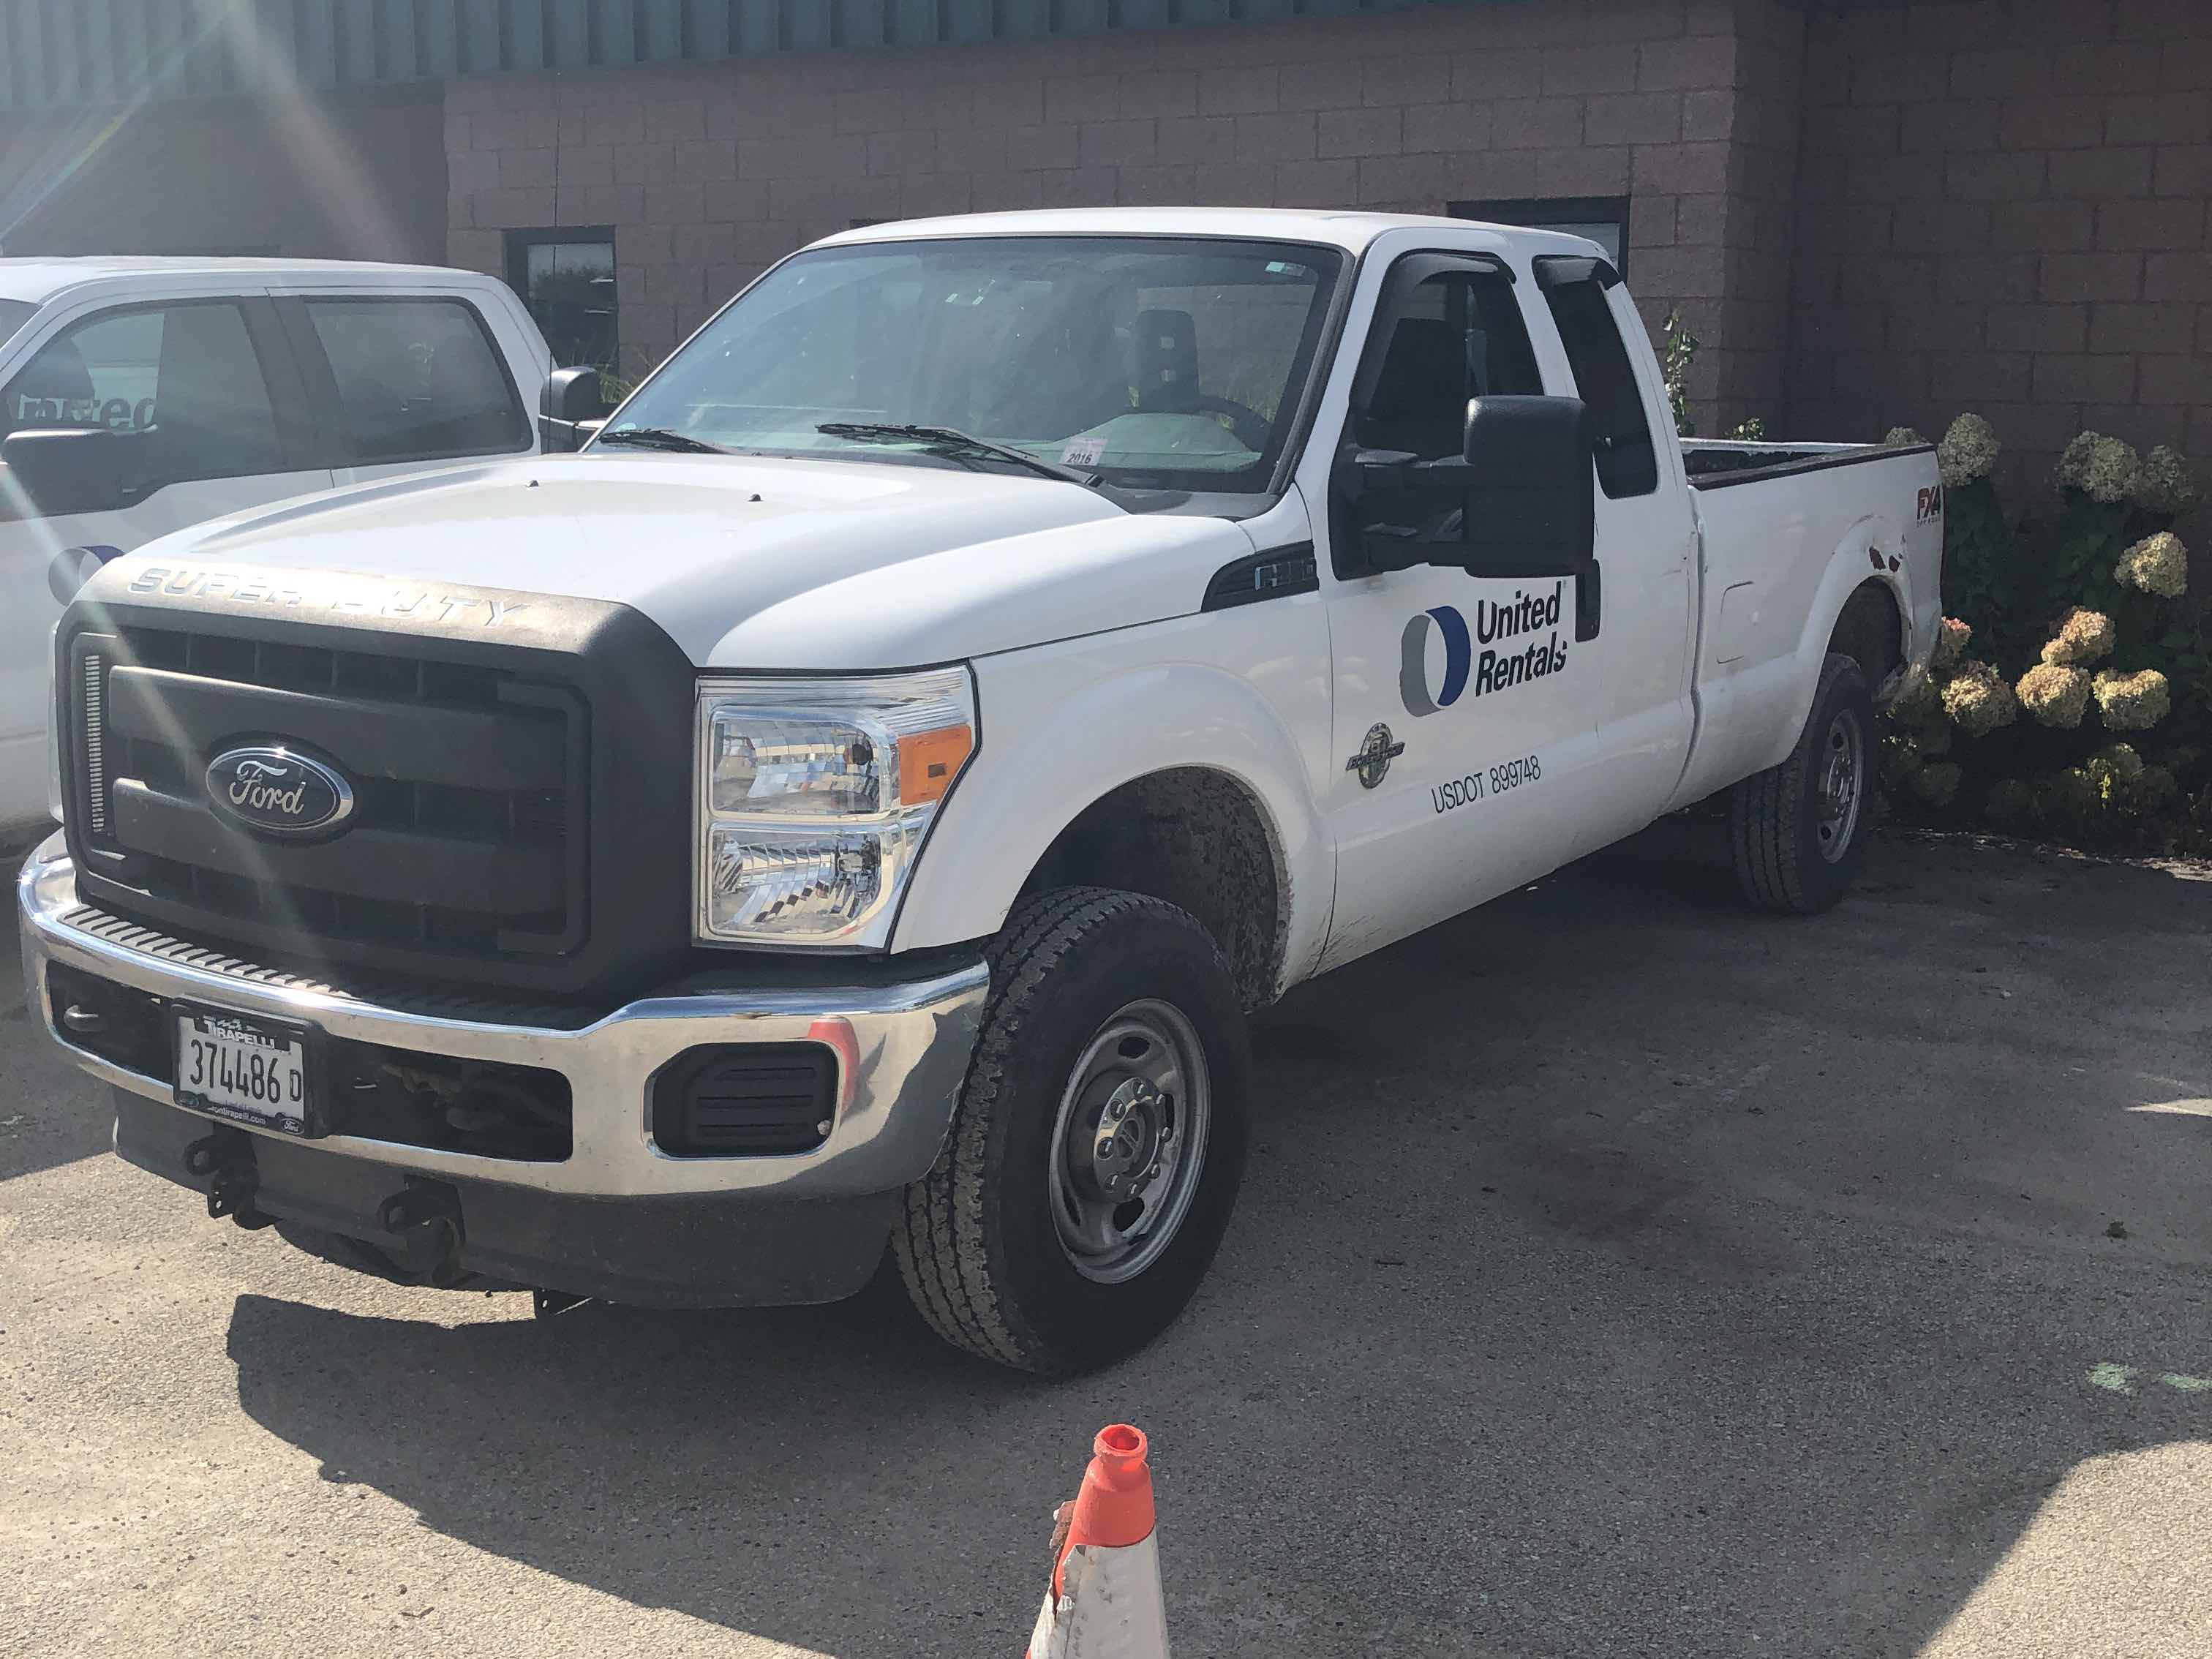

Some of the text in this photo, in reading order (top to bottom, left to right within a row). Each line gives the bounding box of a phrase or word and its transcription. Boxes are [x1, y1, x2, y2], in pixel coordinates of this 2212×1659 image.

[1067, 454, 1092, 464] 2016
[1916, 484, 1941, 520] FX4
[1477, 581, 1562, 644] United
[1475, 631, 1568, 696] Rentals
[229, 760, 306, 814] Ford
[1431, 755, 1541, 814] USDOT 899748
[189, 1039, 281, 1104] 374486
